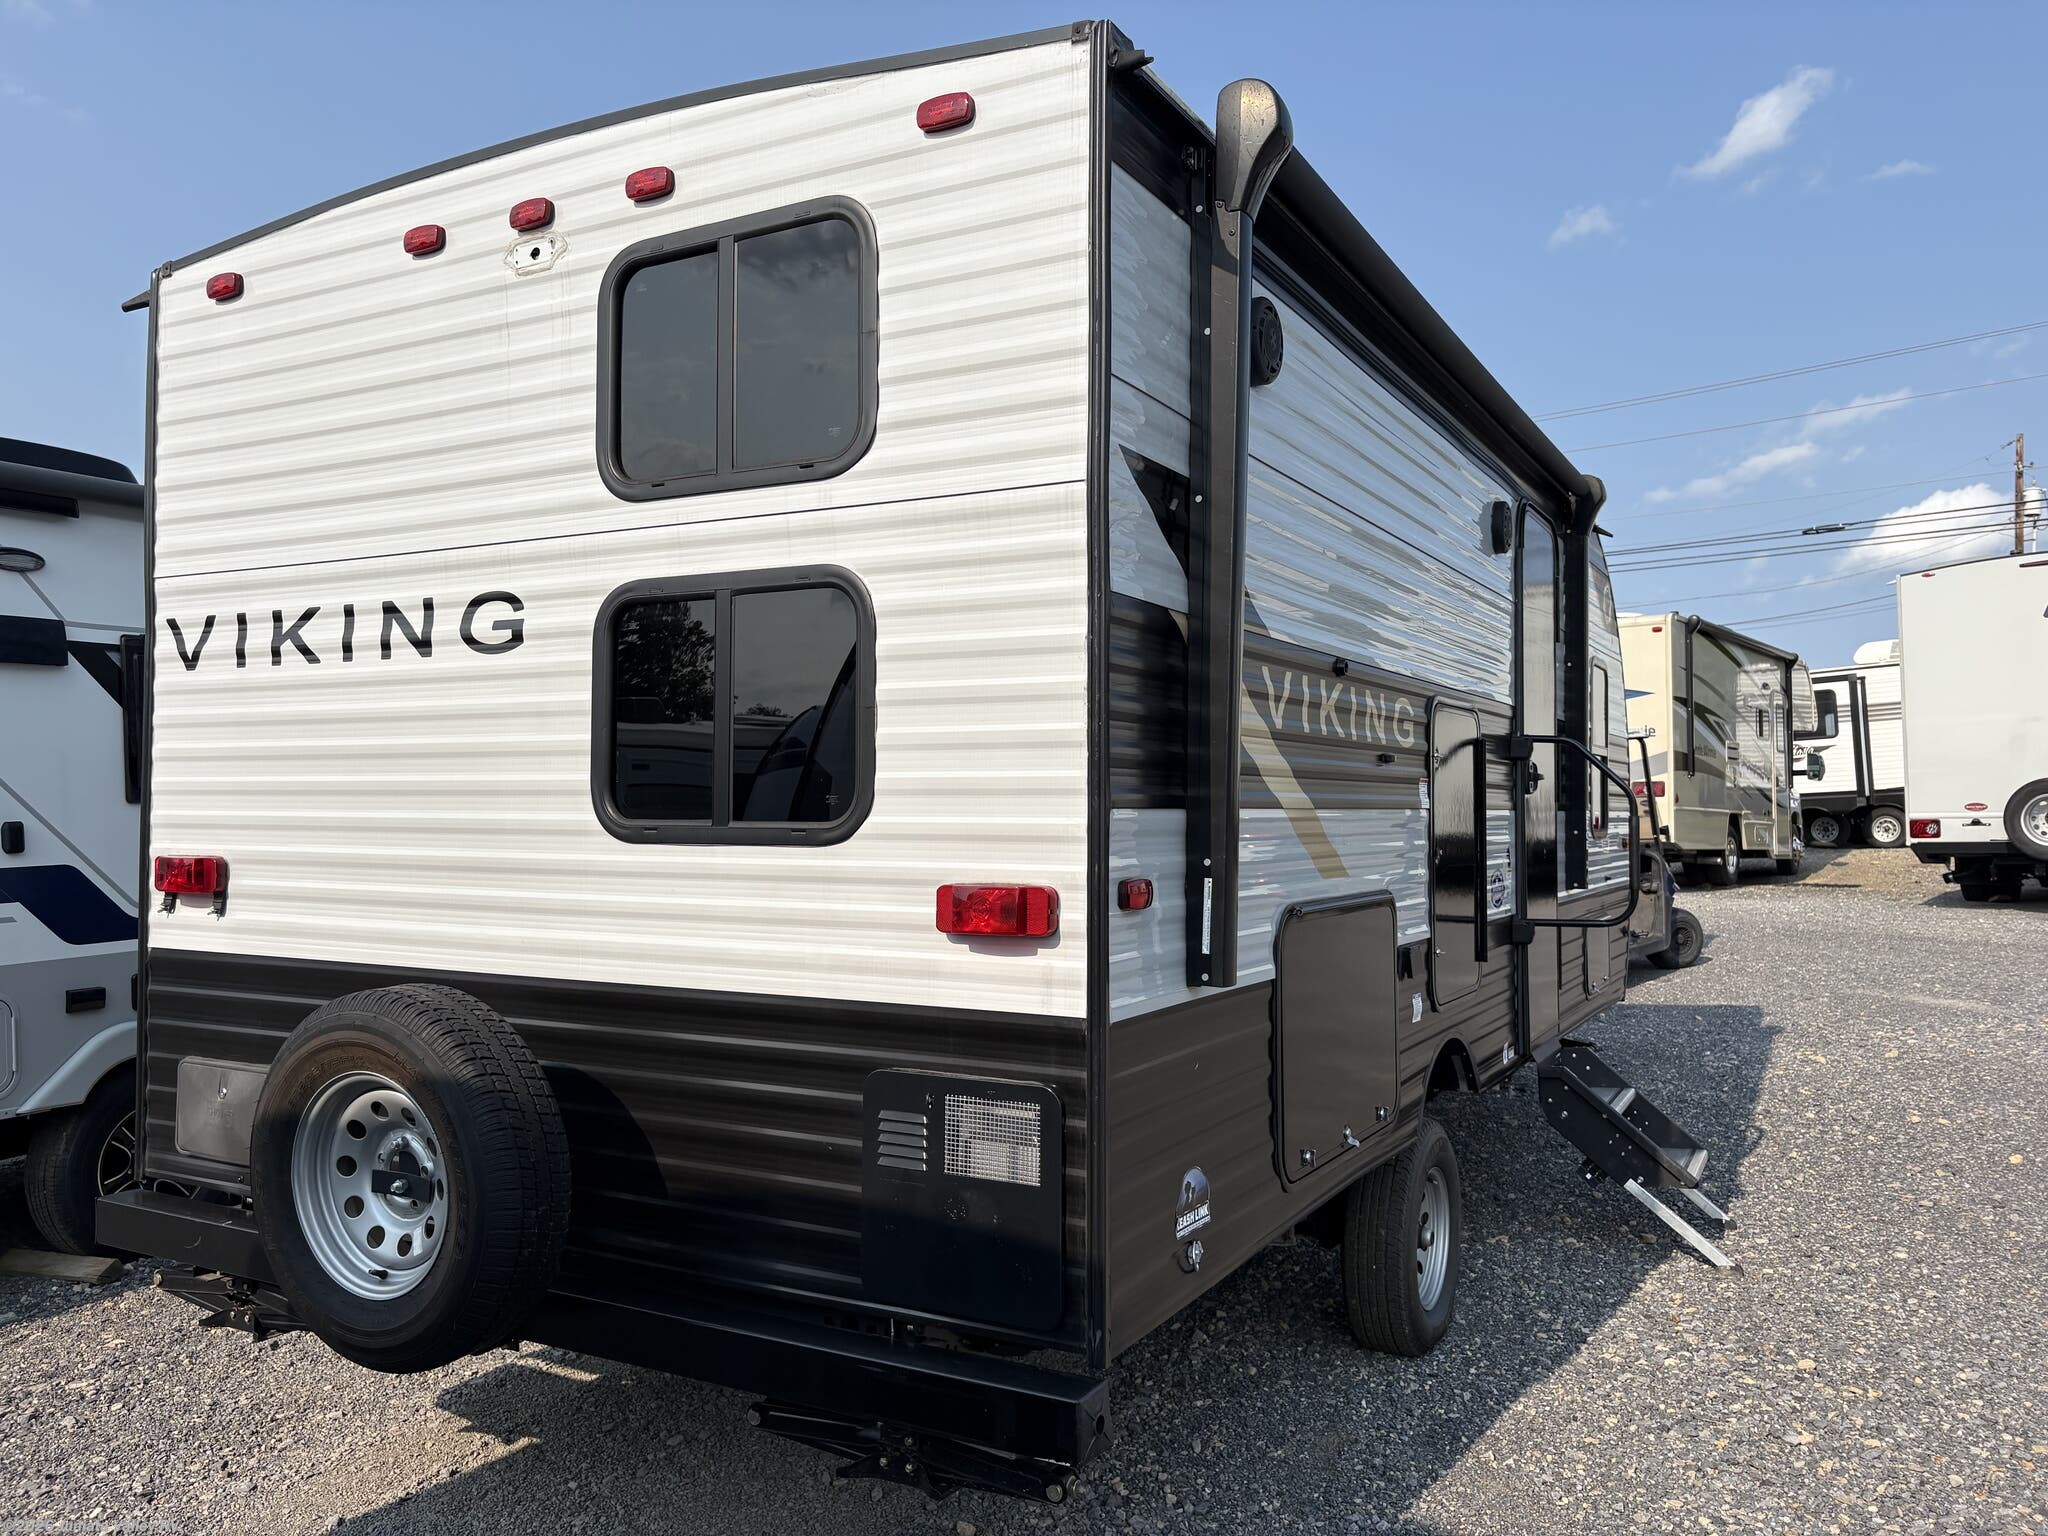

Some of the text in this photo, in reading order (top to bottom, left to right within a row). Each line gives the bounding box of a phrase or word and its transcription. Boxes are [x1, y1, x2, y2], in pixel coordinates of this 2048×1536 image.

[166, 590, 525, 671] VIKING
[1262, 666, 1415, 748] VIKING
[1177, 1203, 1209, 1231] LEASH LINK
